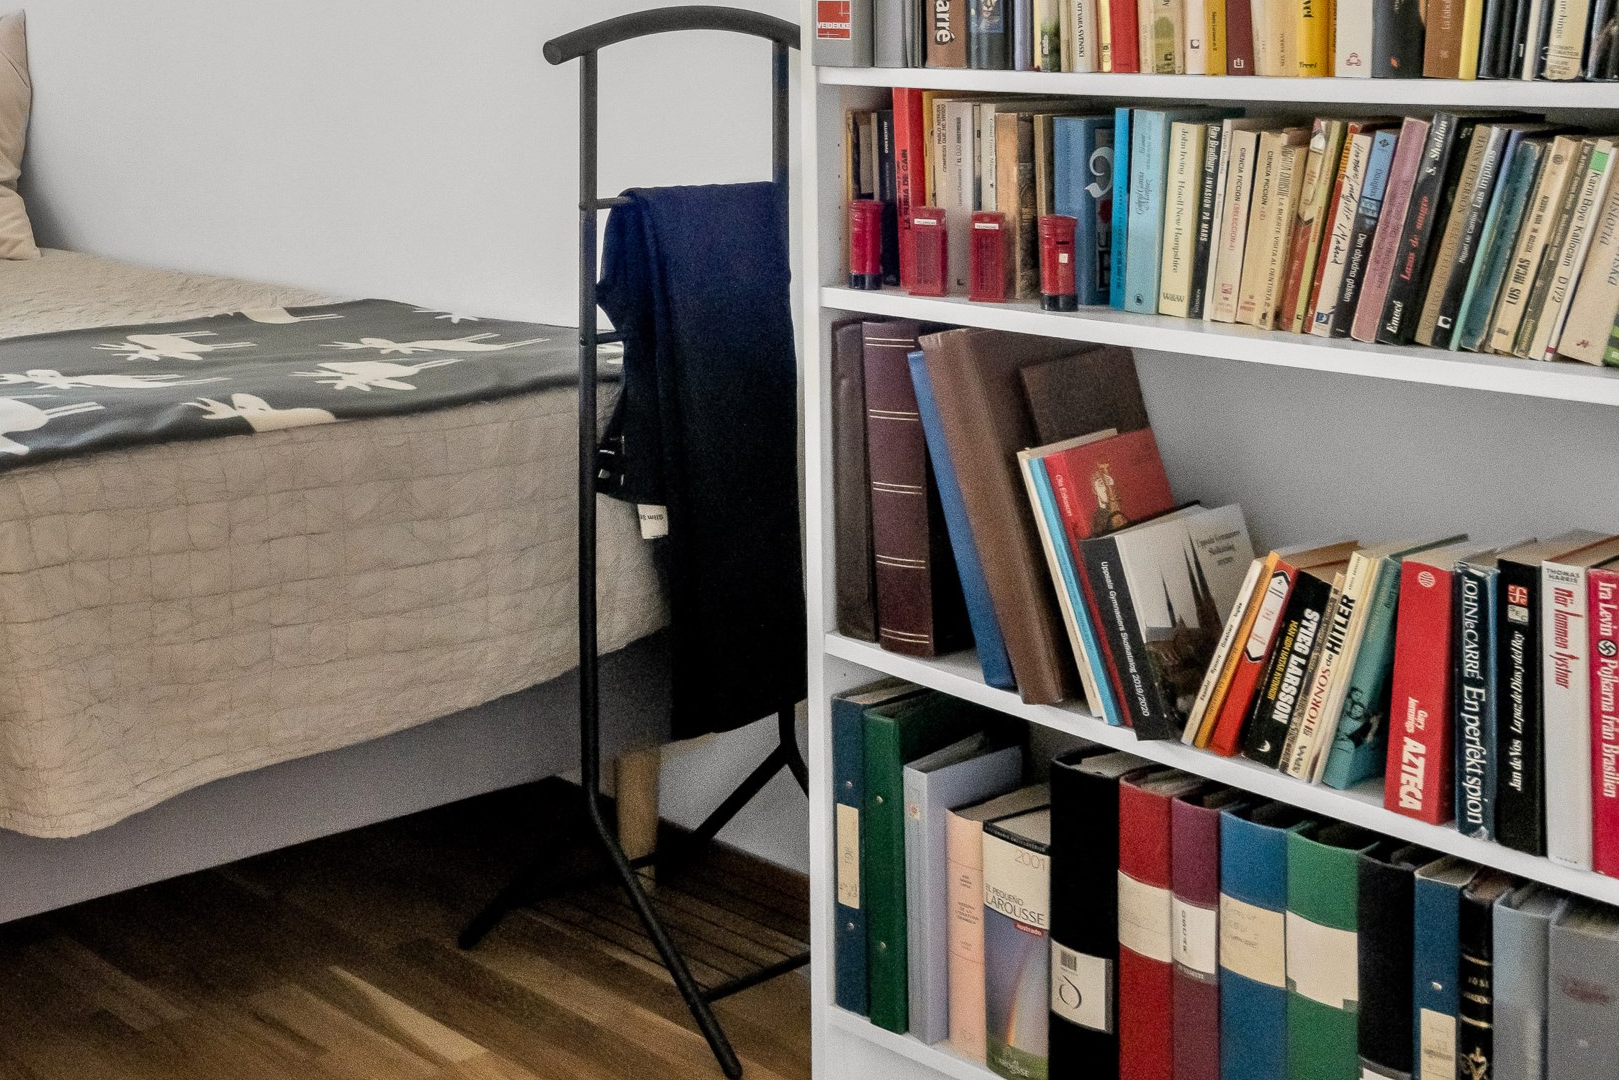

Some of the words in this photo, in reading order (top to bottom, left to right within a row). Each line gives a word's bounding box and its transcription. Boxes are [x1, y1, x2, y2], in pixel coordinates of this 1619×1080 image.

[1180, 128, 1188, 144] John
[1208, 126, 1220, 139] Ray
[1429, 120, 1448, 161] Sheldon
[1178, 146, 1188, 175] Irving
[1205, 140, 1219, 173] Bradbury
[1237, 147, 1247, 174] CIENCIA
[1264, 150, 1274, 177] CIENCIA
[1425, 165, 1436, 176] S.
[1476, 150, 1497, 189] impuras
[1177, 180, 1186, 206] Hotell
[1203, 177, 1214, 208] INVASION
[1234, 174, 1244, 202] FICCION
[1260, 178, 1270, 205] FICCION
[1584, 171, 1602, 196] Karin
[1414, 195, 1428, 230] sangre
[1471, 190, 1484, 208] Las
[1576, 198, 1593, 221] Boye
[1175, 207, 1184, 225] New
[1199, 223, 1211, 242] MARS
[1356, 233, 1367, 248] Den
[1409, 235, 1420, 248] de
[1563, 225, 1585, 267] Kallocain
[1171, 227, 1183, 273] Hampshire
[1348, 248, 1364, 277] objudna
[1399, 252, 1416, 281] Lazos
[1511, 257, 1531, 285] INCAS
[1342, 278, 1356, 303] gästen
[1505, 287, 1518, 305] LOS
[1386, 300, 1404, 334] Emecé
[1056, 474, 1065, 486] Ola
[1463, 576, 1479, 619] JOHN
[1553, 587, 1574, 608] När
[1598, 581, 1617, 600] Ira
[1293, 608, 1320, 653] STIEG
[1325, 594, 1356, 655] HITLER
[1553, 609, 1584, 649] lammen
[1598, 602, 1617, 636] Levin
[1100, 561, 1114, 590] Uppsala
[1108, 590, 1125, 632] Gymnasiers
[1119, 632, 1137, 673] Skolkatalog
[1132, 674, 1150, 717] 2019/2020
[1324, 654, 1334, 667] de
[1464, 628, 1483, 679] CARRÉ
[1271, 654, 1306, 725] LARSSON
[1464, 685, 1485, 710] En
[1600, 657, 1618, 712] Pojkarna
[1305, 668, 1332, 732] HORNOS
[1404, 696, 1419, 734] Jennings
[1414, 709, 1429, 730] Gary
[1601, 714, 1619, 741] från
[1460, 712, 1487, 775] perfekt
[1509, 739, 1522, 757] Vos
[1399, 736, 1427, 811] AZTECA
[1510, 758, 1522, 770] de
[1602, 742, 1619, 798] Brasilien
[1509, 772, 1522, 791] Jan
[1462, 776, 1487, 825] spion
[1015, 849, 1045, 871] 2001
[985, 883, 991, 891] EL
[985, 892, 1044, 926] LAROUSSE
